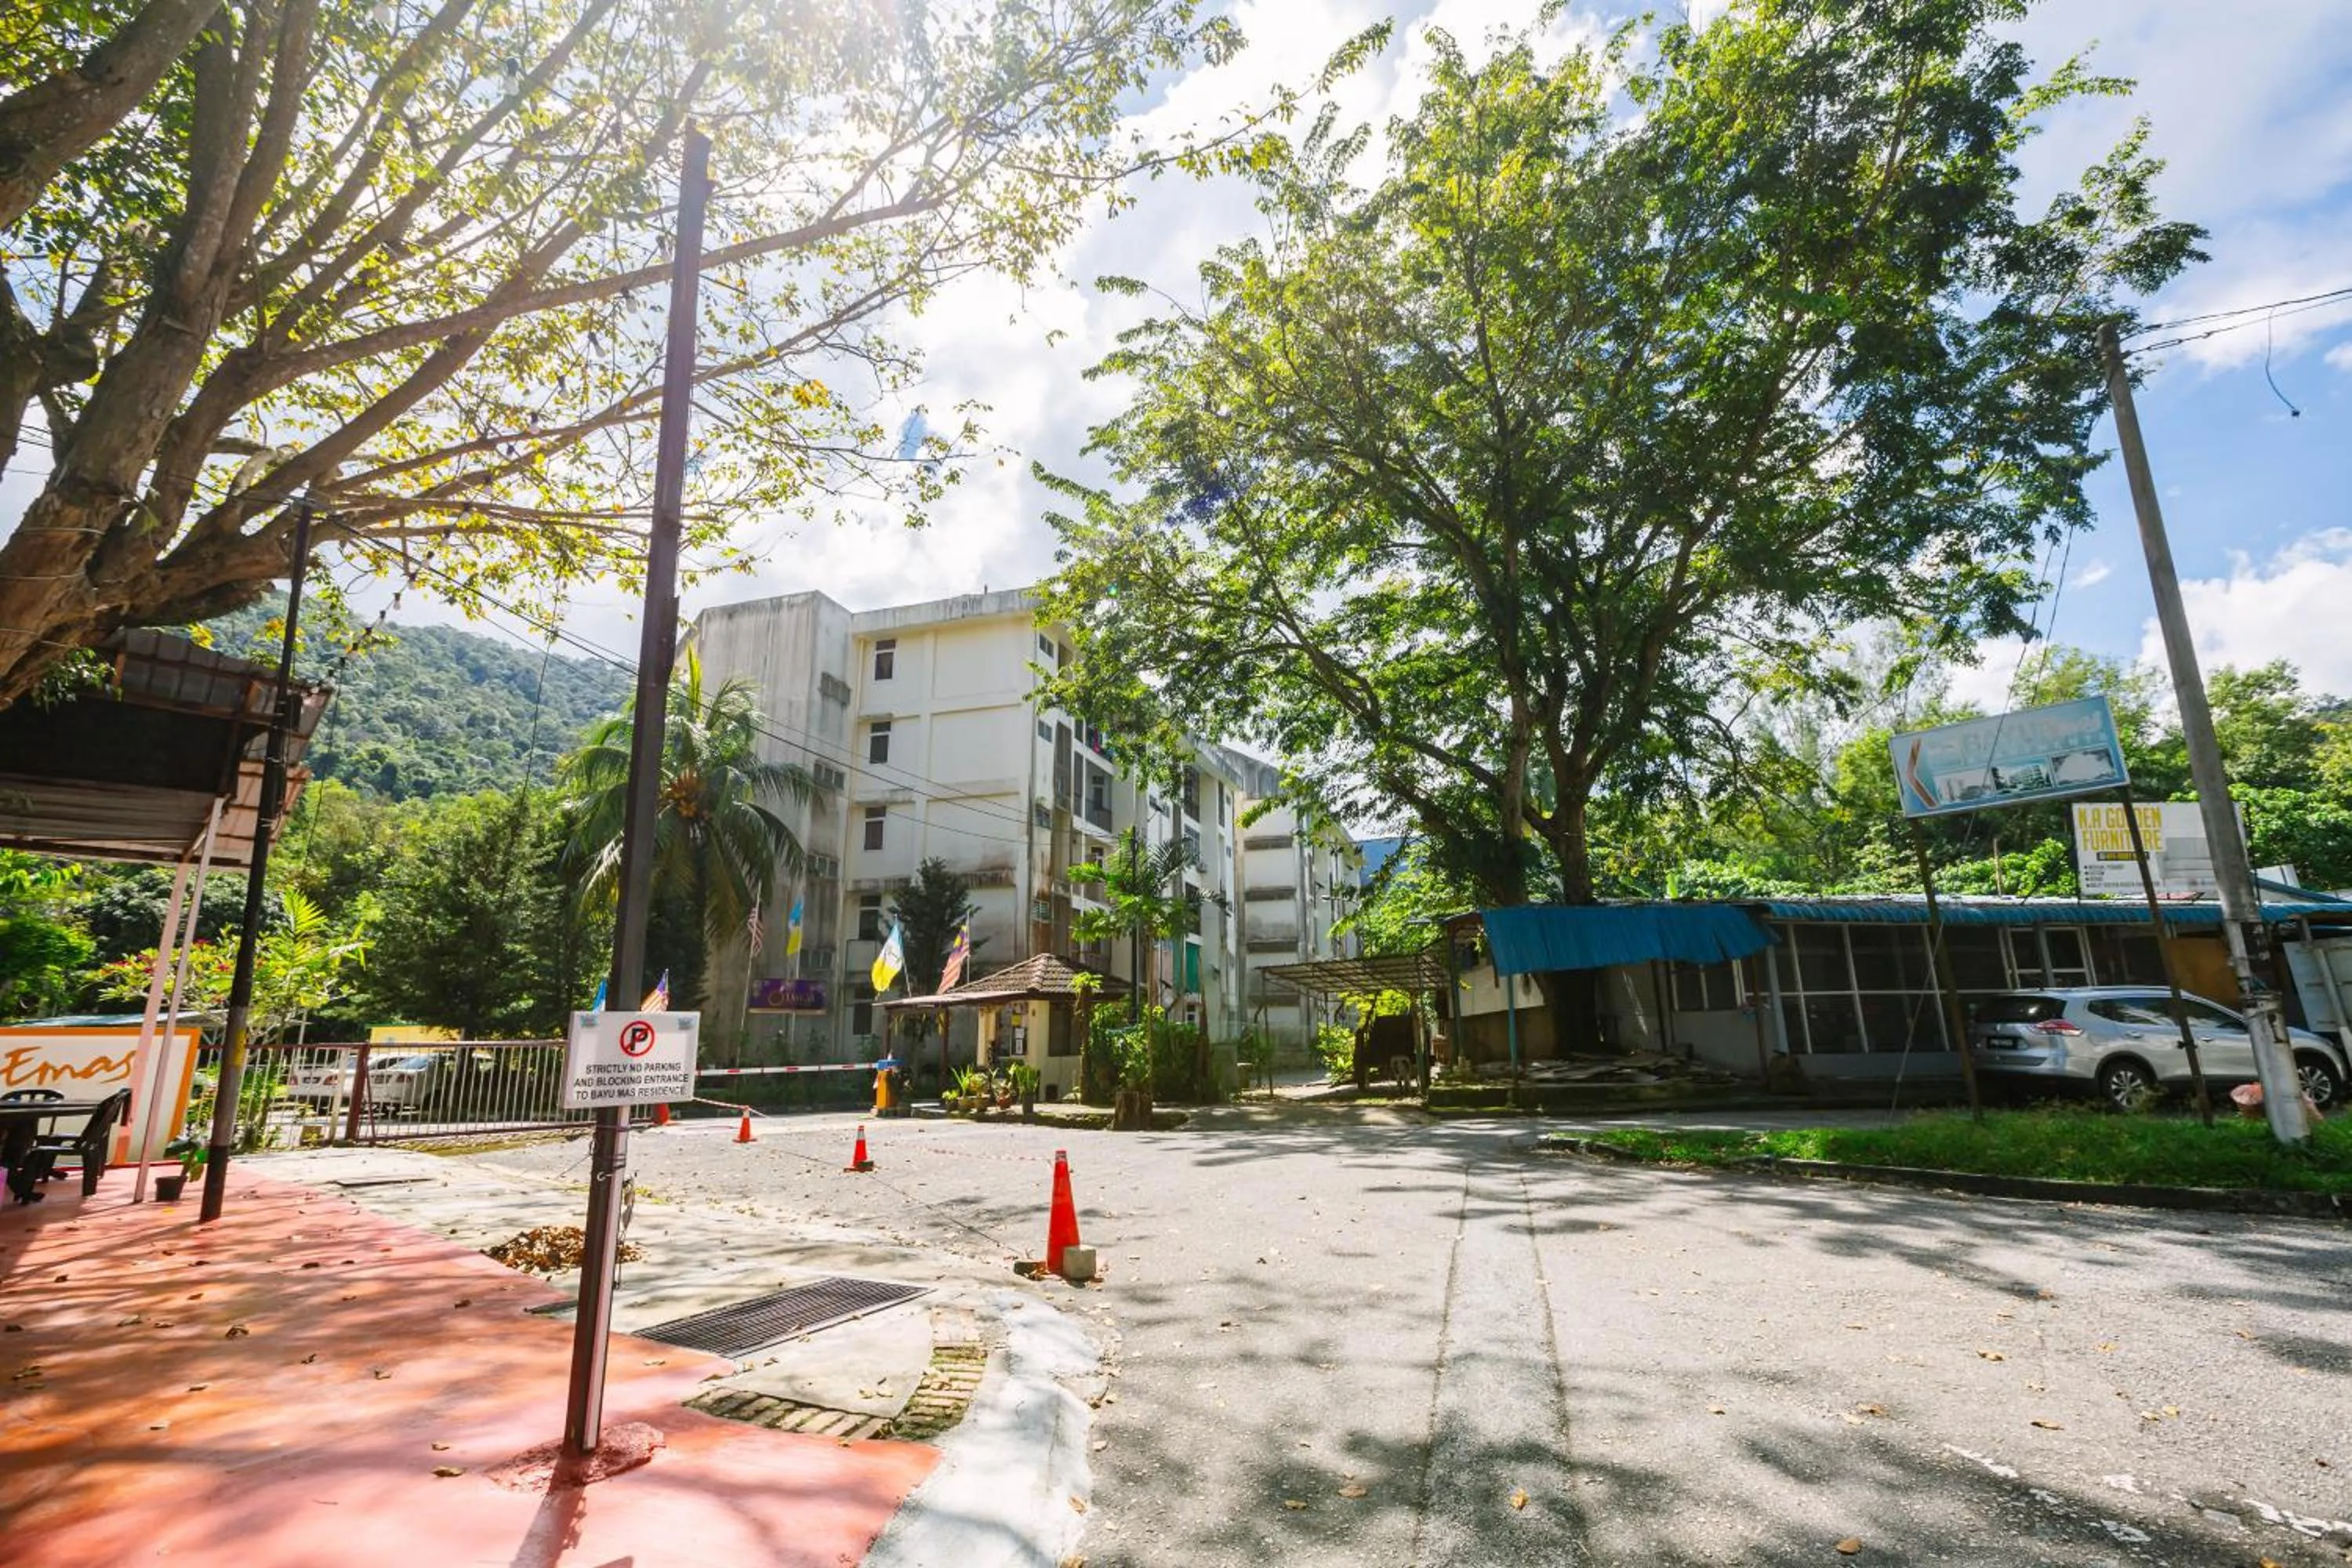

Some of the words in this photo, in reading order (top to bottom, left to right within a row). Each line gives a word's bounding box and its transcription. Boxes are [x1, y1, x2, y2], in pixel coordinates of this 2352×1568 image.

[2078, 807, 2100, 829] N.A
[2106, 807, 2161, 829] GODEN
[2082, 829, 2161, 851] FURNITRE
[0, 1046, 136, 1086] Emas
[586, 1064, 627, 1074] STRICTLY
[644, 1062, 681, 1072] PARKING
[574, 1077, 593, 1087] AND
[597, 1075, 642, 1086] BLOCKING
[644, 1073, 689, 1083] ENTRANCE
[575, 1091, 589, 1100] TO
[590, 1089, 615, 1099] BAYU
[617, 1087, 636, 1098] MAS
